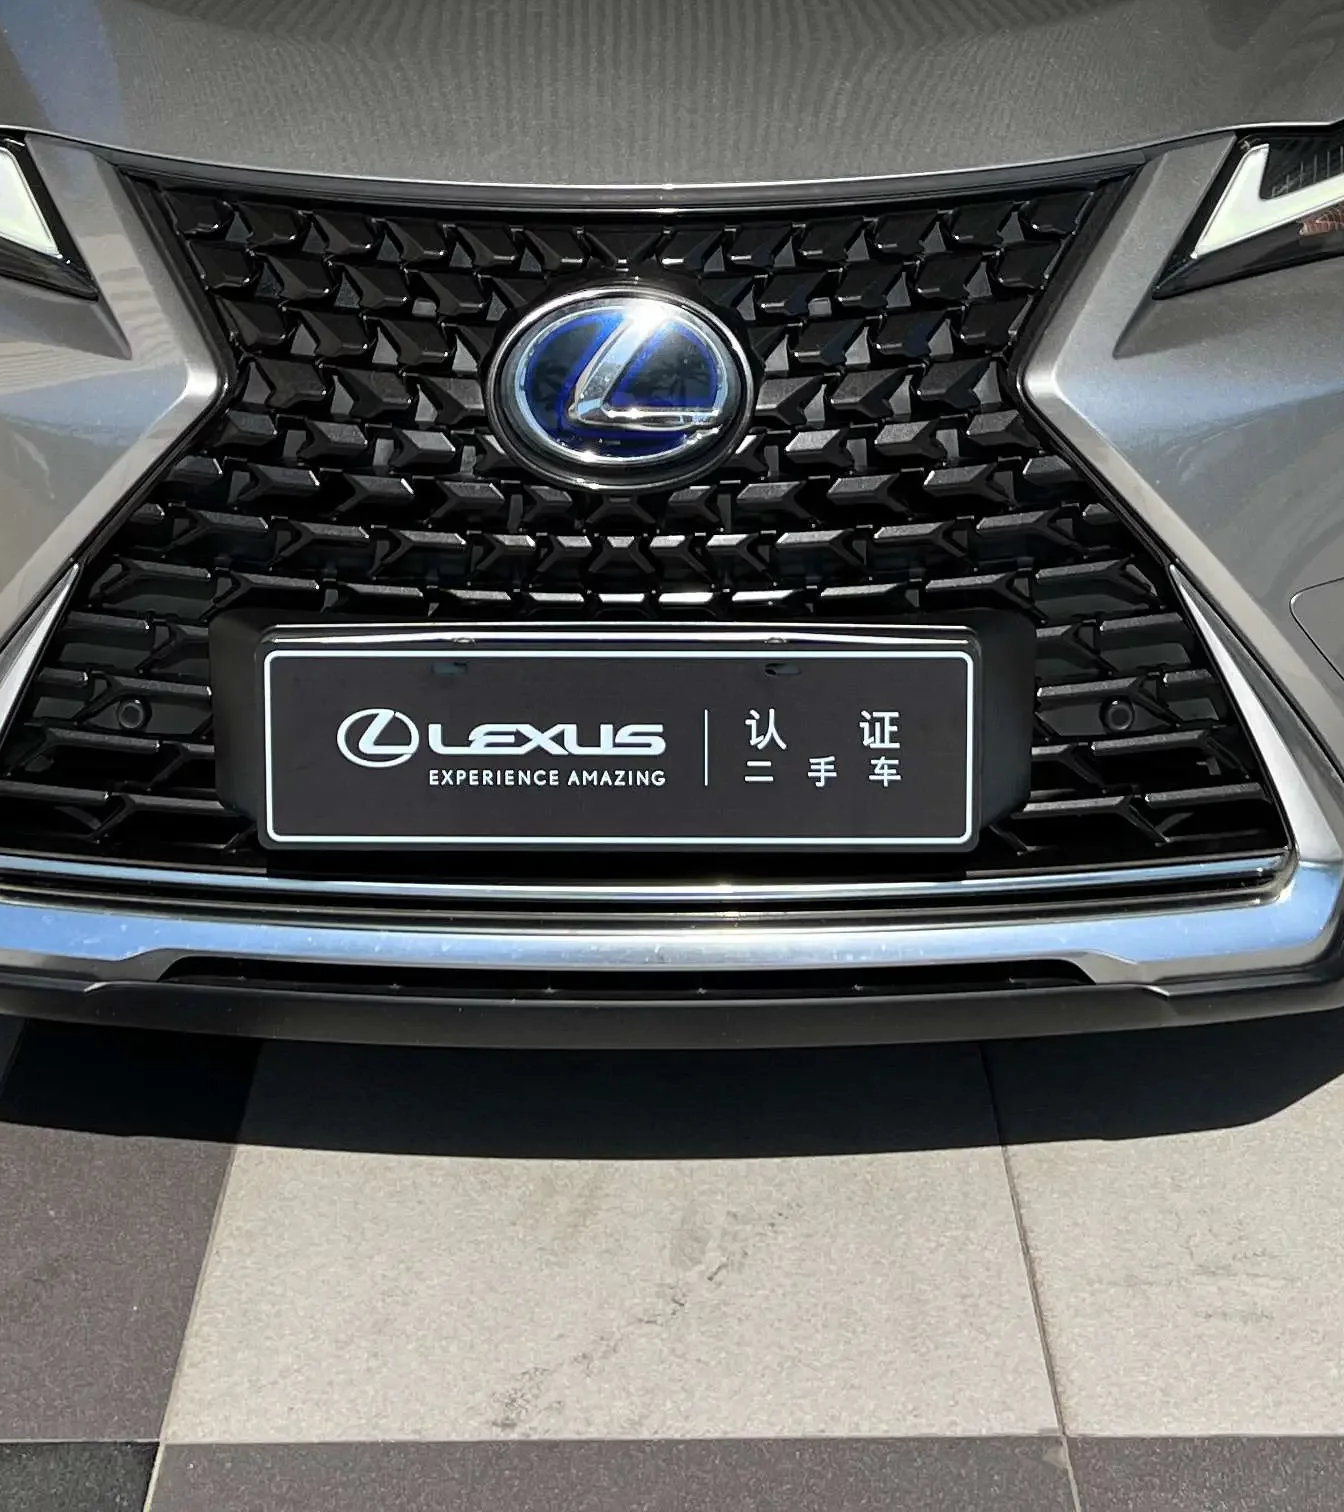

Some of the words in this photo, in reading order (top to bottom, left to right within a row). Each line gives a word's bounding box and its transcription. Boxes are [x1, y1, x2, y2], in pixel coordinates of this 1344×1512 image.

[428, 723, 666, 756] LEXUS
[745, 708, 901, 751] 认证
[429, 769, 560, 787] EXPERIENCE
[567, 769, 666, 787] AMAZING
[744, 756, 901, 787] 二手车
